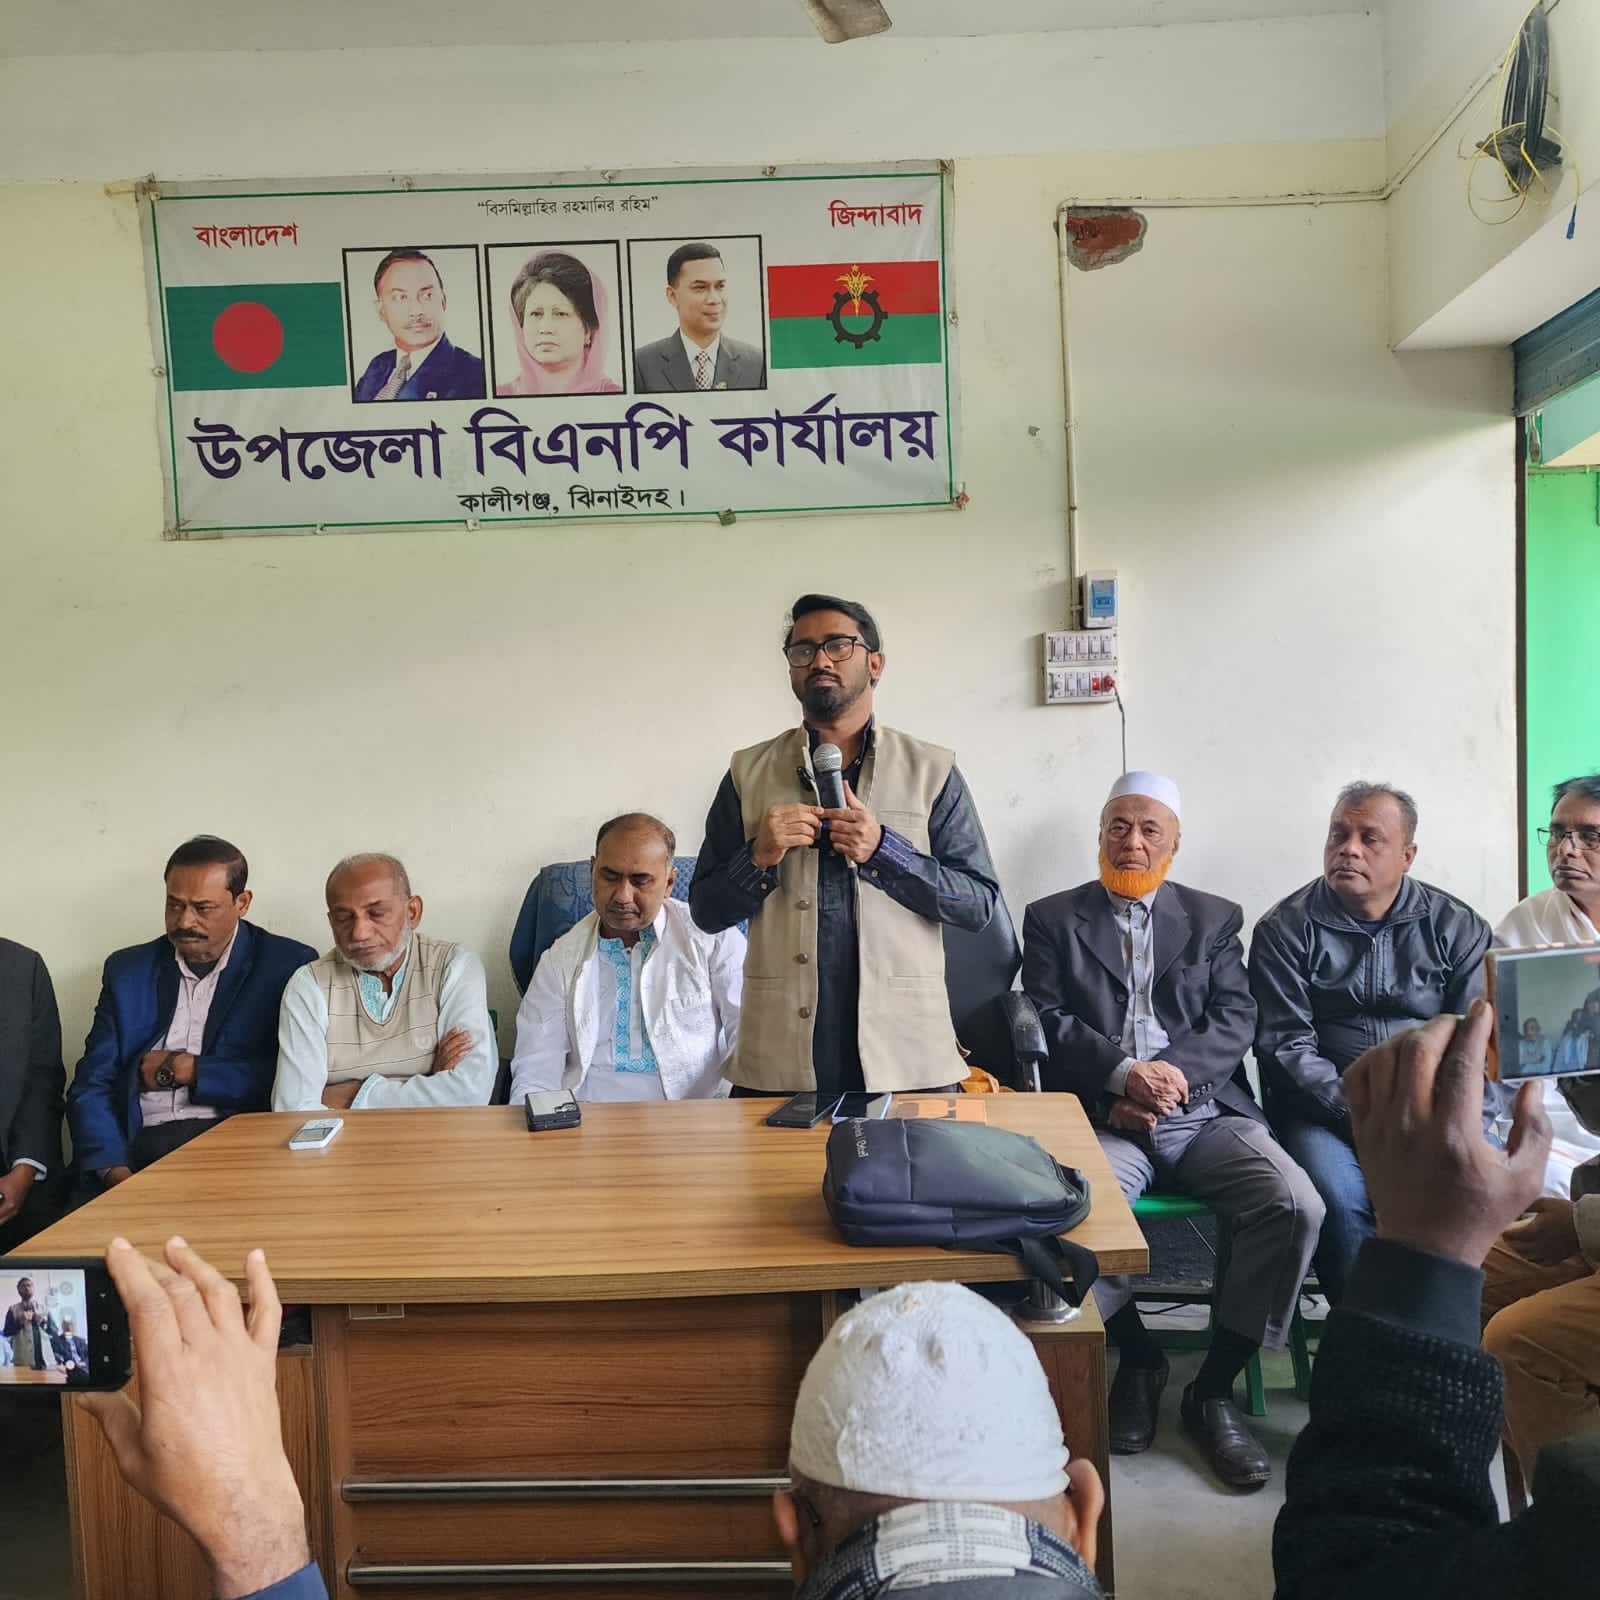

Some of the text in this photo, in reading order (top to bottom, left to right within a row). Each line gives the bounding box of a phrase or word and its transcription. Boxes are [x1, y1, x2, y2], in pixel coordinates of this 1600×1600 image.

[562, 195, 615, 214] রহমানির
[827, 199, 924, 228] জিন্দাবাদ
[192, 221, 299, 249] বাংলাদেশ
[185, 392, 941, 483] উপজেলা বিএনপি কার্যালয়
[456, 485, 560, 514] কালীগঞ্জ,
